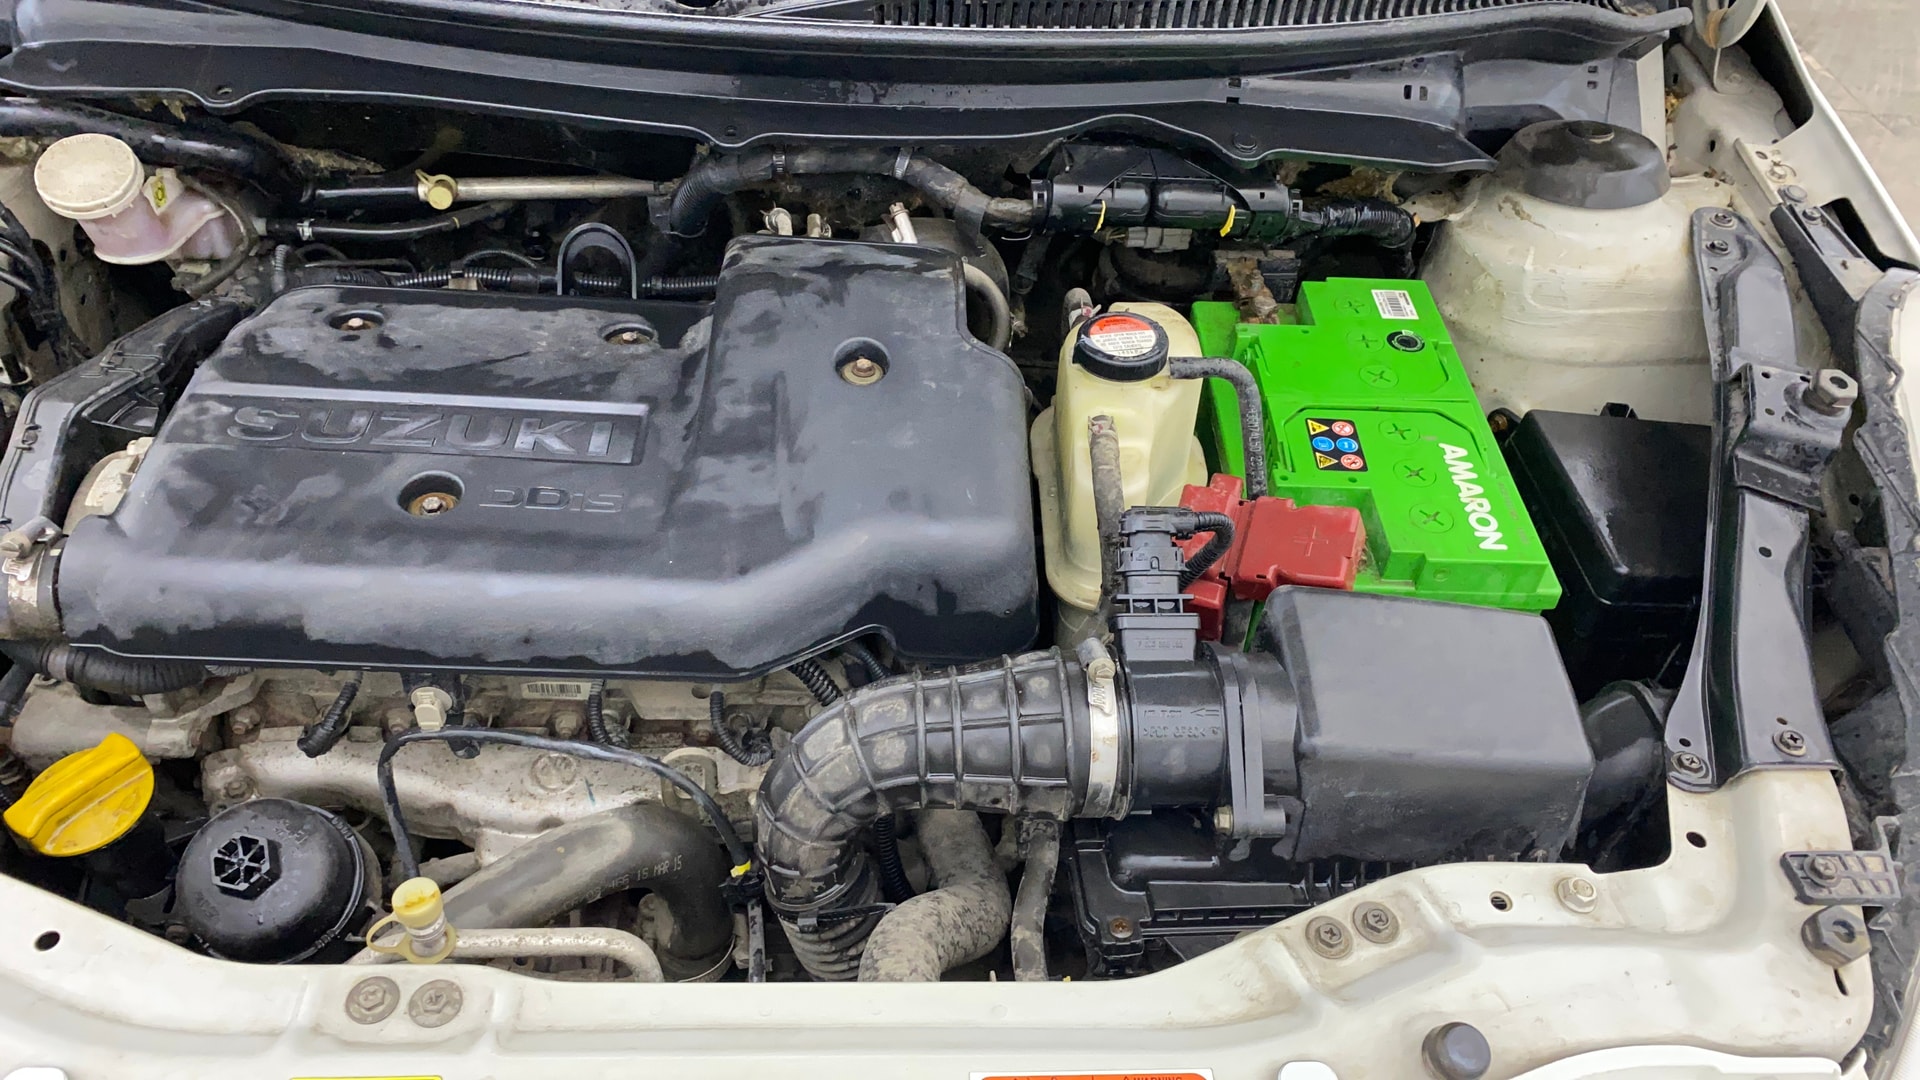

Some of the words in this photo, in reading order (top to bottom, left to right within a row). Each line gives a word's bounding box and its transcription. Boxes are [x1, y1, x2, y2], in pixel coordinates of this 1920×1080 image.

[226, 405, 616, 457] SUZUKI
[1438, 442, 1509, 551] AMARON
[653, 860, 670, 877] MAR
[673, 854, 683, 872] 15
